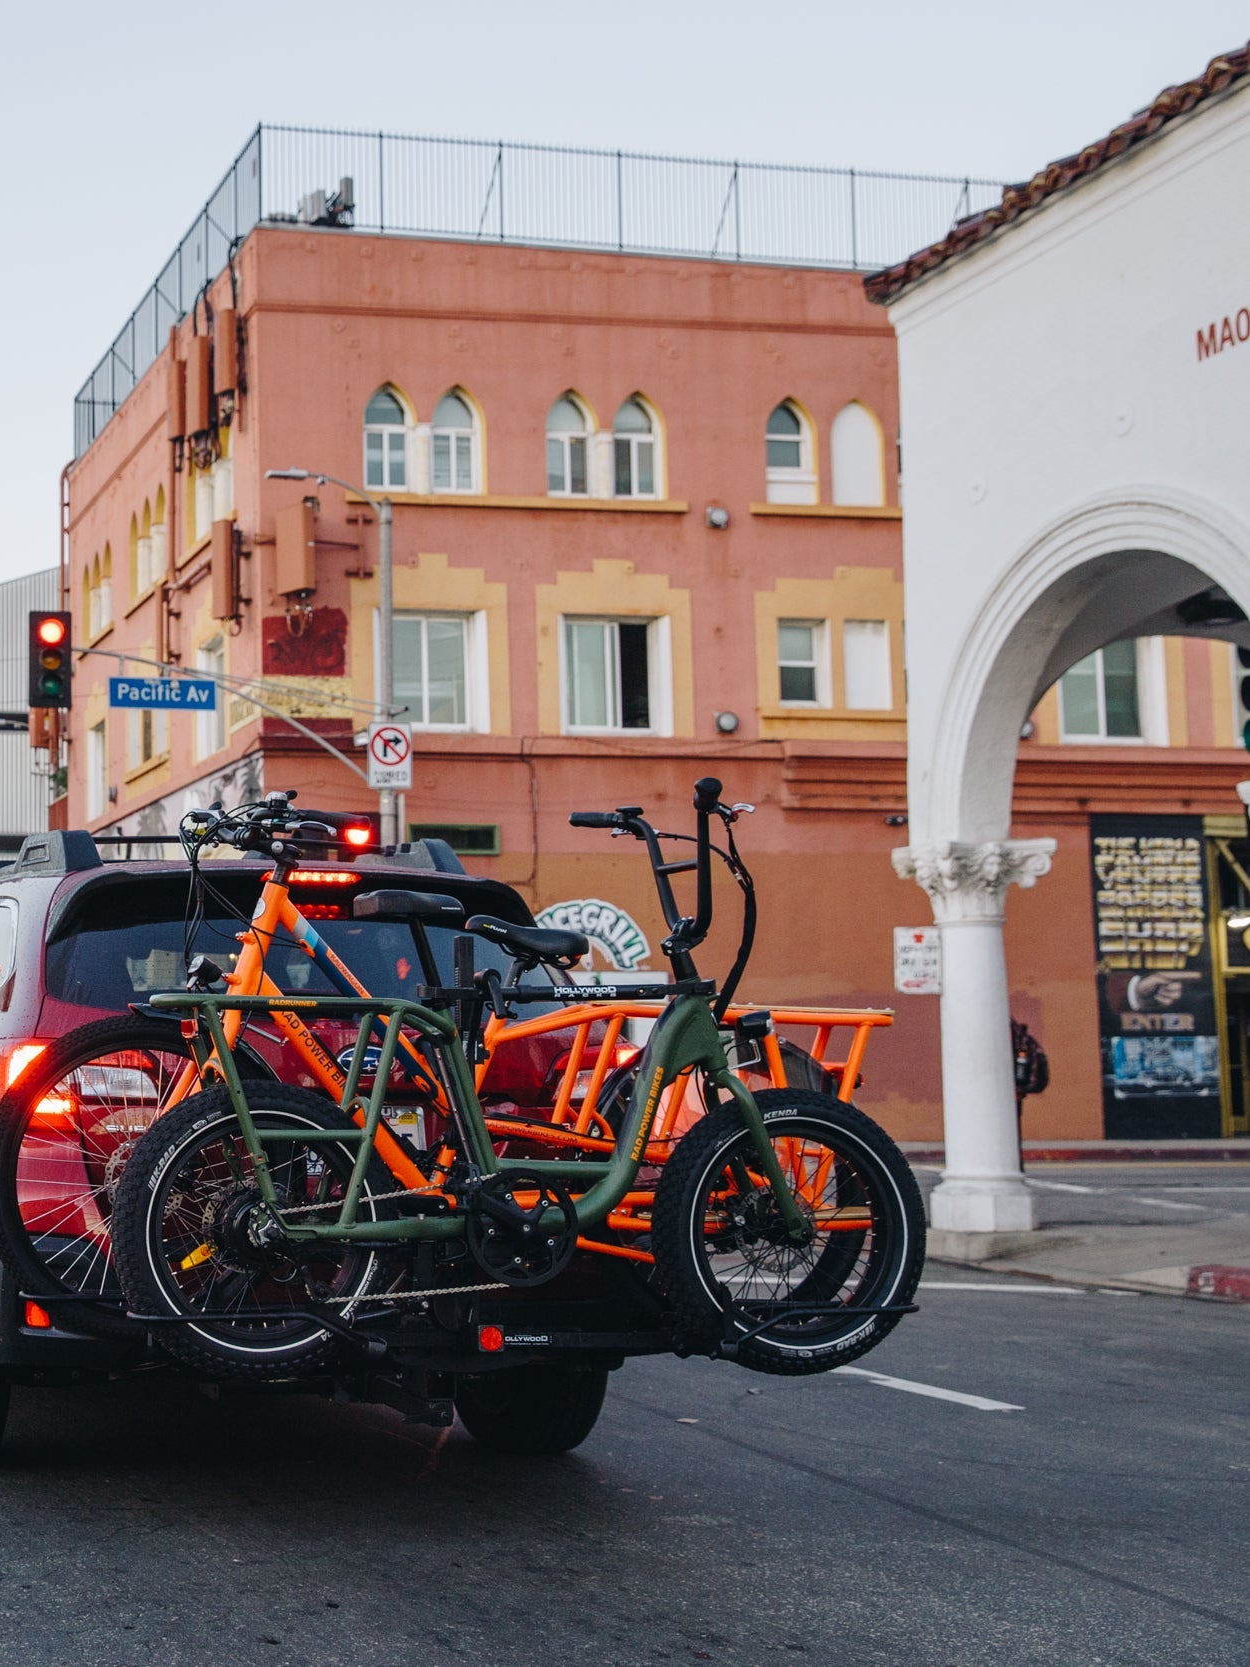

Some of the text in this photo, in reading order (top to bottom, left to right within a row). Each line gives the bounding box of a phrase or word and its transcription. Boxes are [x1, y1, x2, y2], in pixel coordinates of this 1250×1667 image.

[117, 683, 210, 703] Pacific Av
[553, 986, 617, 994] HOLLYWOOD
[268, 998, 318, 1007] RADRUNNER
[1120, 1012, 1195, 1031] ENTER
[281, 1011, 301, 1030] AD
[298, 1031, 335, 1073] POWER
[630, 1065, 665, 1162] RAD POWER BIKES
[763, 1108, 799, 1120] KENDA
